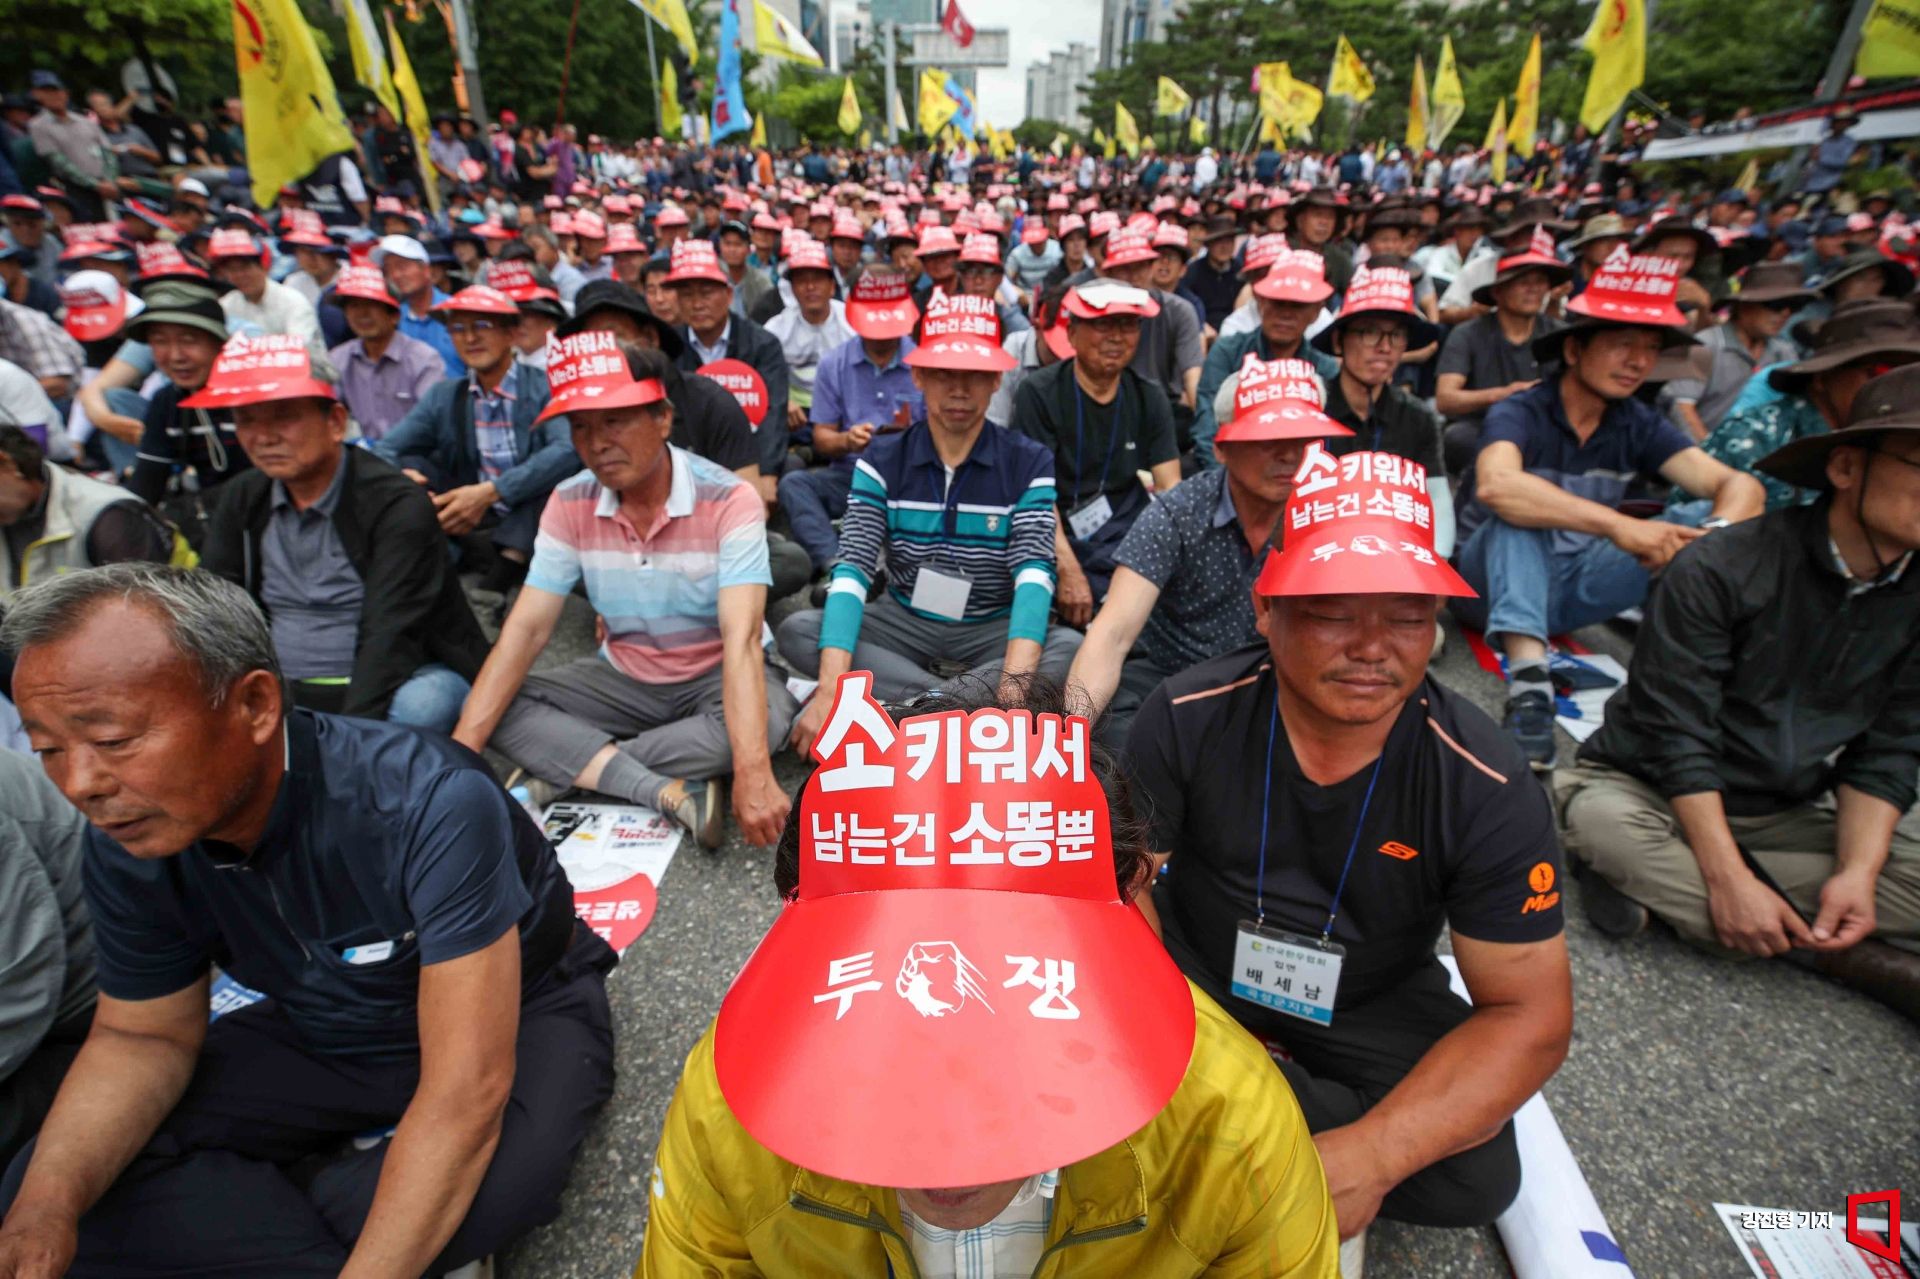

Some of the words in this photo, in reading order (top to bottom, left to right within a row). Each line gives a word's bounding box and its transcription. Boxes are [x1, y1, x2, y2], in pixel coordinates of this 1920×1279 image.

[1291, 493, 1360, 530] 남는건
[1366, 489, 1430, 529] 소똥뿐
[811, 812, 936, 866] 남는건
[949, 801, 1095, 867] 소똥뿐
